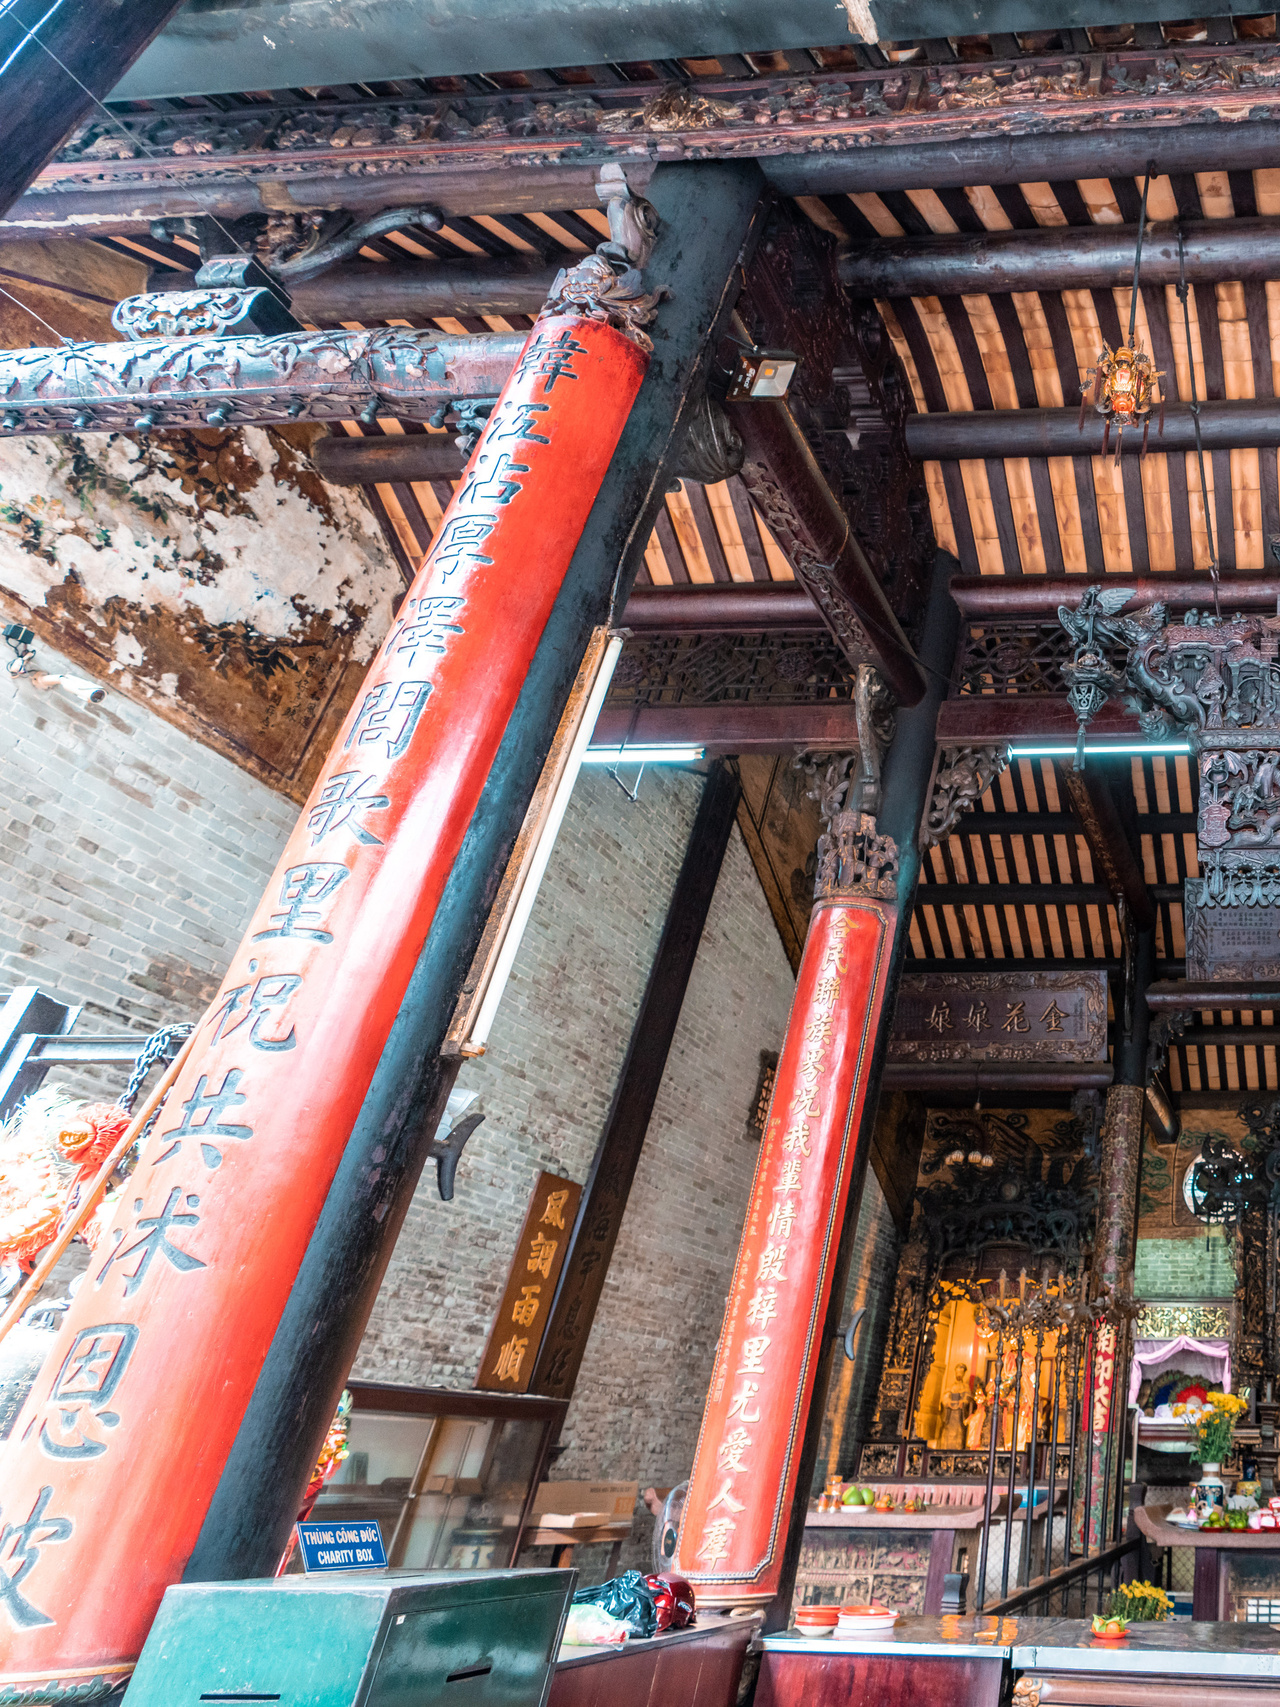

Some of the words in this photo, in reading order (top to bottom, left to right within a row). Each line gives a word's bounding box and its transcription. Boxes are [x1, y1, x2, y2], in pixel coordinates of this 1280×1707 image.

[925, 999, 1070, 1034] 金花娘娘
[491, 1188, 570, 1383] 風調雨順
[303, 1528, 335, 1545] THÙNG
[336, 1526, 360, 1544] CÔNG
[360, 1526, 378, 1543] ĐỨC
[317, 1549, 354, 1565] CHARITY
[355, 1548, 374, 1562] BOX
